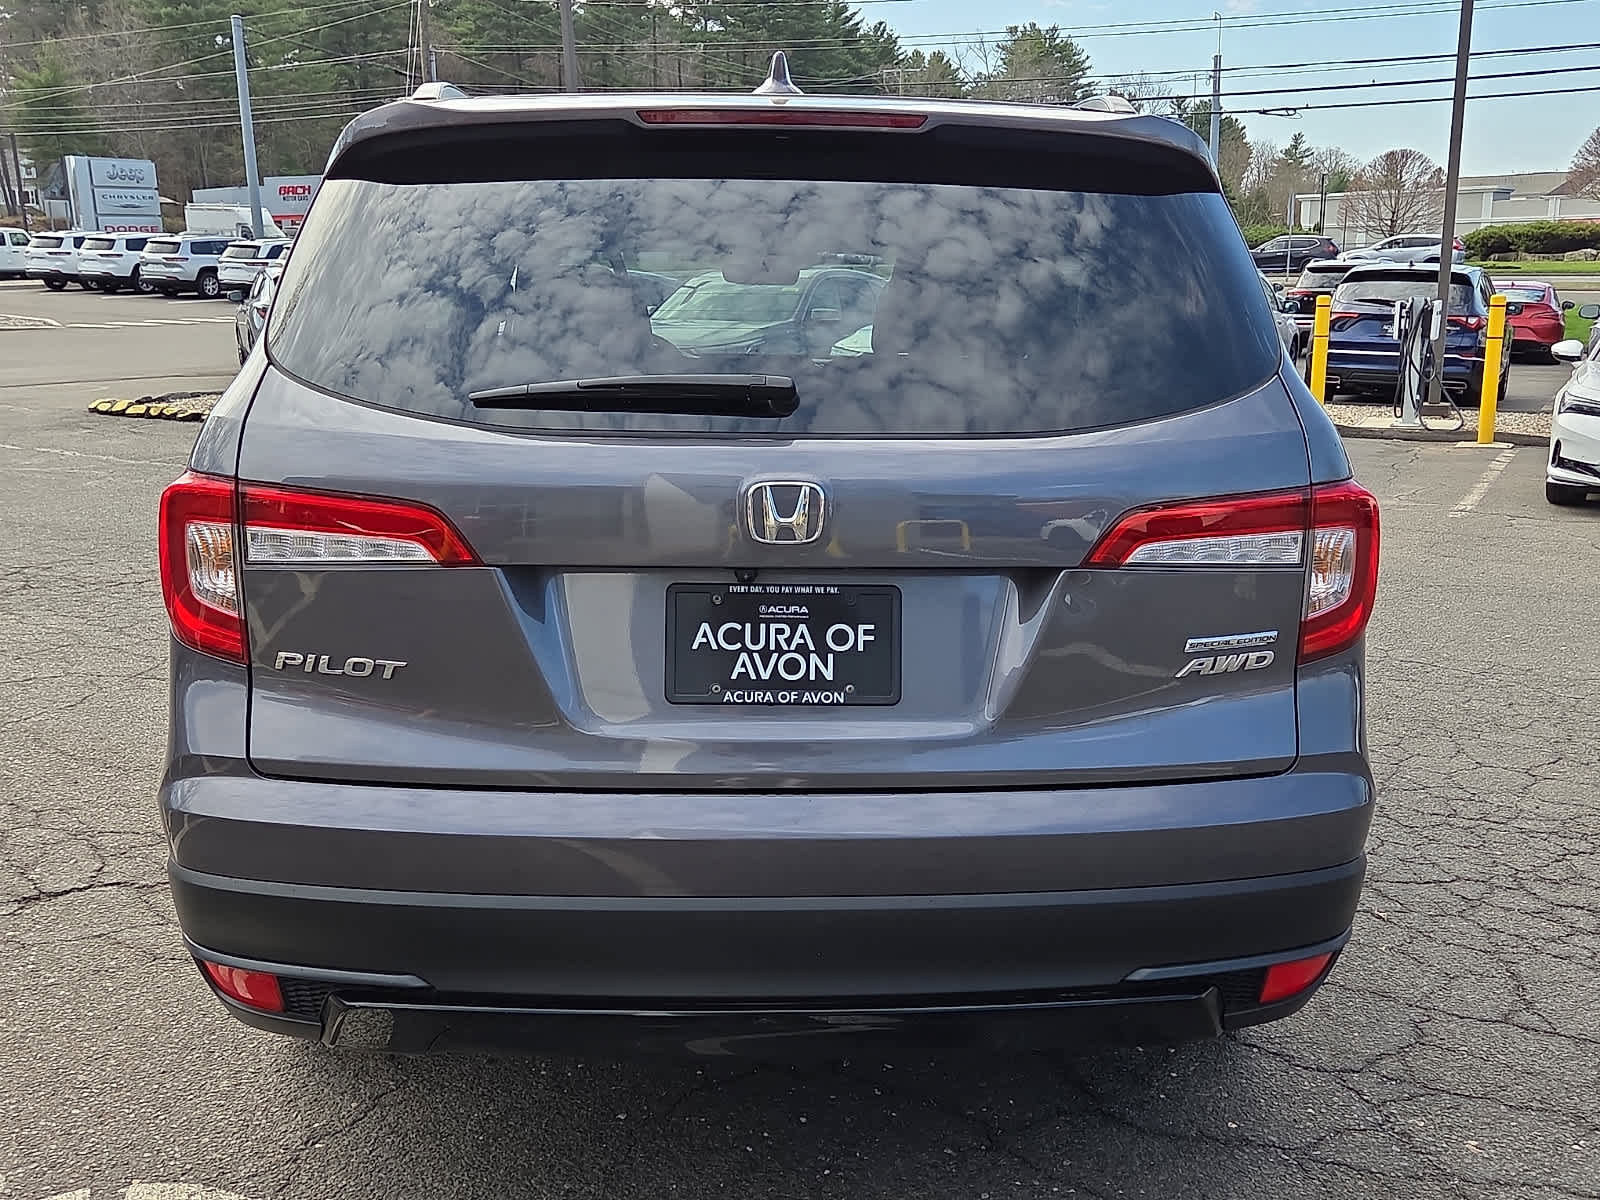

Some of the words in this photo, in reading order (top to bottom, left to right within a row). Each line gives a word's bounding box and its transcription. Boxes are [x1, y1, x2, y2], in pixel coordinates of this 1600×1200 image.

[106, 163, 145, 184] Jeep
[729, 585, 748, 593] EVERY
[794, 586, 813, 594] WHAT
[814, 586, 825, 594] WE
[767, 605, 809, 614] ACURA
[691, 622, 816, 651] ACURA
[825, 623, 876, 652] OF
[1188, 639, 1235, 649] SPECIAL
[1236, 634, 1278, 645] EDITION
[274, 651, 408, 680] PILOT
[730, 652, 834, 681] AVON
[1174, 650, 1275, 678] AWD
[723, 691, 774, 703] ACURA
[778, 691, 799, 704] OF
[802, 692, 845, 704] AVON
